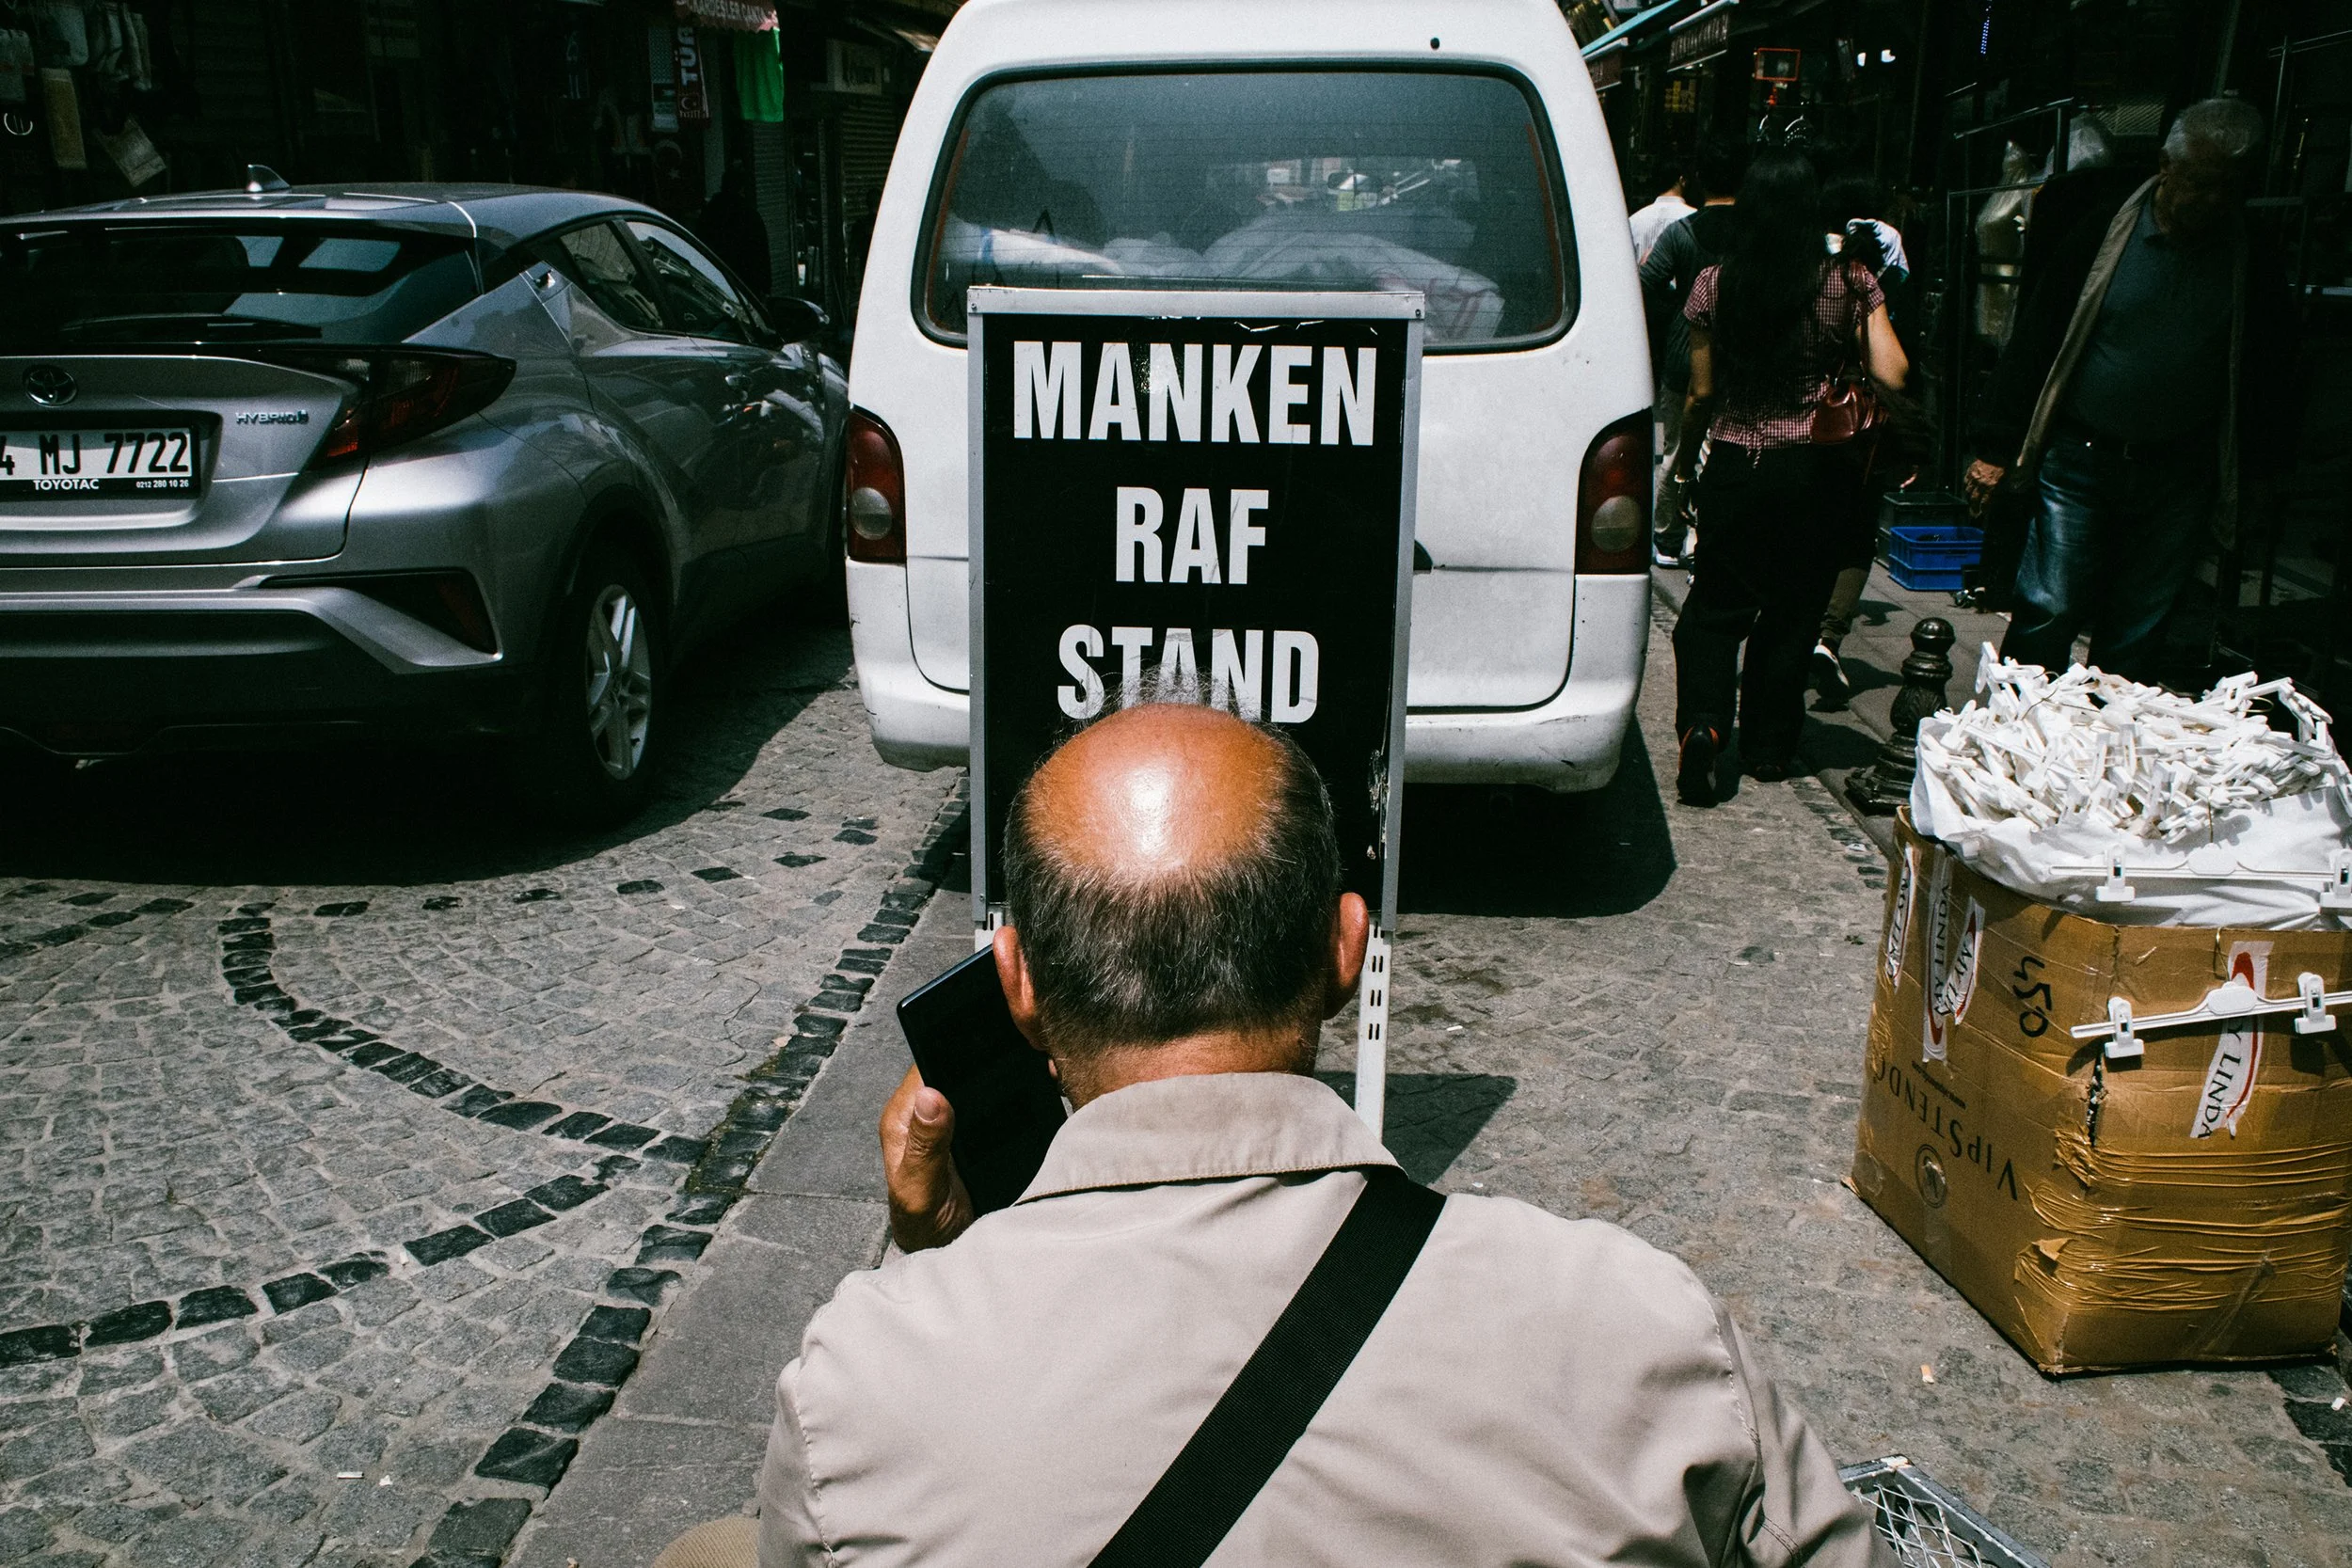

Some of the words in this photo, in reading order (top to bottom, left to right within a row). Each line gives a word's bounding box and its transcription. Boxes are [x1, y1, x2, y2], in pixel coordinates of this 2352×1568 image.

[235, 412, 296, 424] HYBRID
[1013, 341, 1377, 446] MANKEN
[33, 479, 100, 490] TOYOTAC
[40, 434, 81, 475] MJ
[104, 432, 189, 474] 7722
[152, 480, 167, 488] 280
[168, 479, 179, 488] 10
[179, 479, 189, 487] 26
[1116, 486, 1269, 585] RAF
[1057, 625, 1319, 723] STAND
[2198, 1053, 2241, 1138] LINDA
